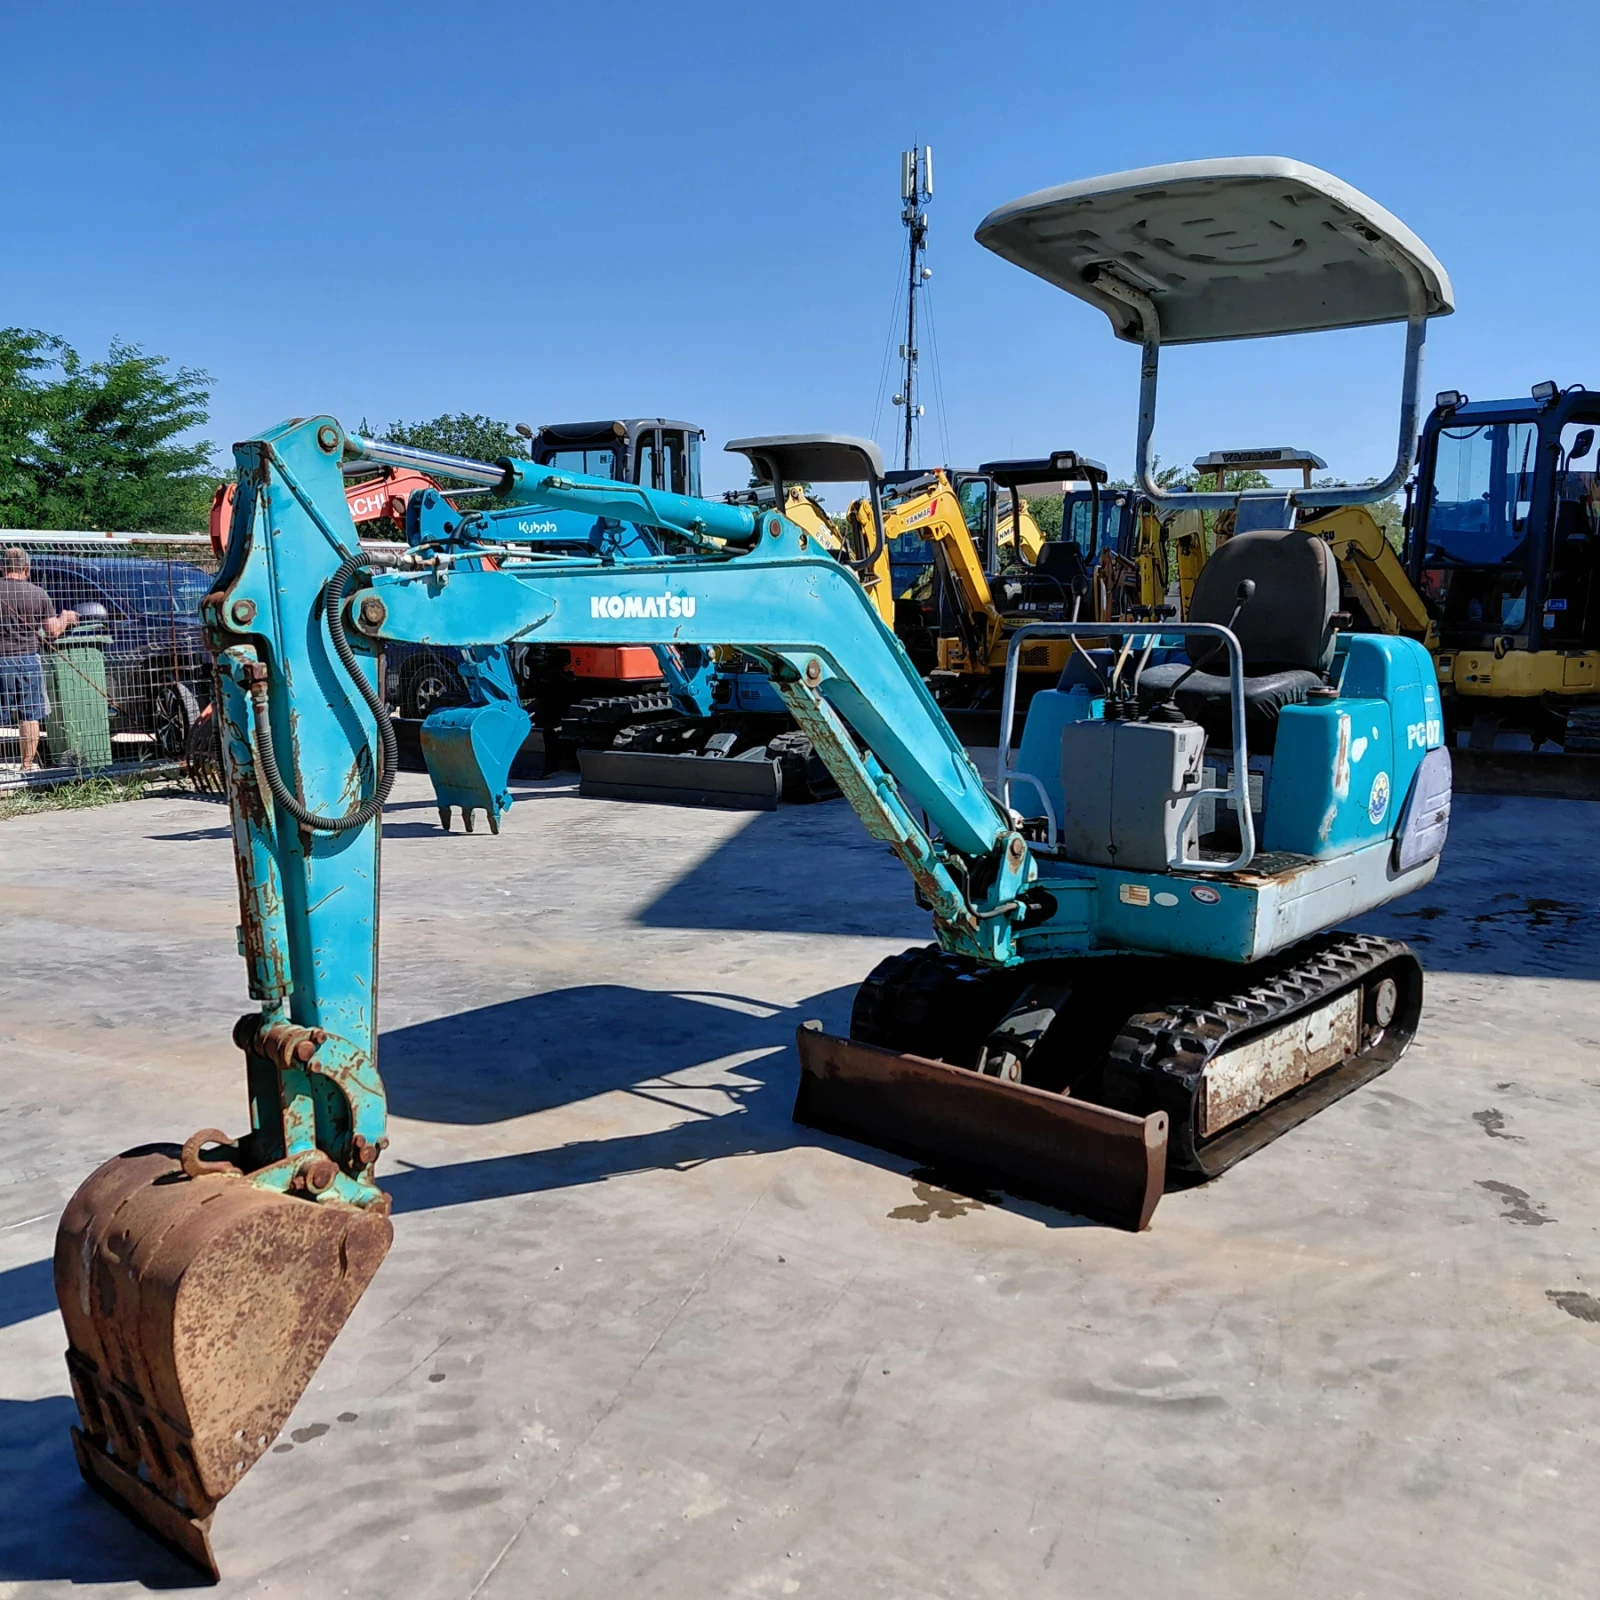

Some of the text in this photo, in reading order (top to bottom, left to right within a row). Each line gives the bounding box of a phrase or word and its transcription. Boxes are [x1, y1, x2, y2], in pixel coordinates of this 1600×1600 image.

[1221, 450, 1282, 462] YANMAR
[905, 507, 931, 526] YANMAR
[518, 520, 557, 534] Kubota
[590, 591, 696, 618] KOMATSU
[1407, 719, 1440, 750] PC07
